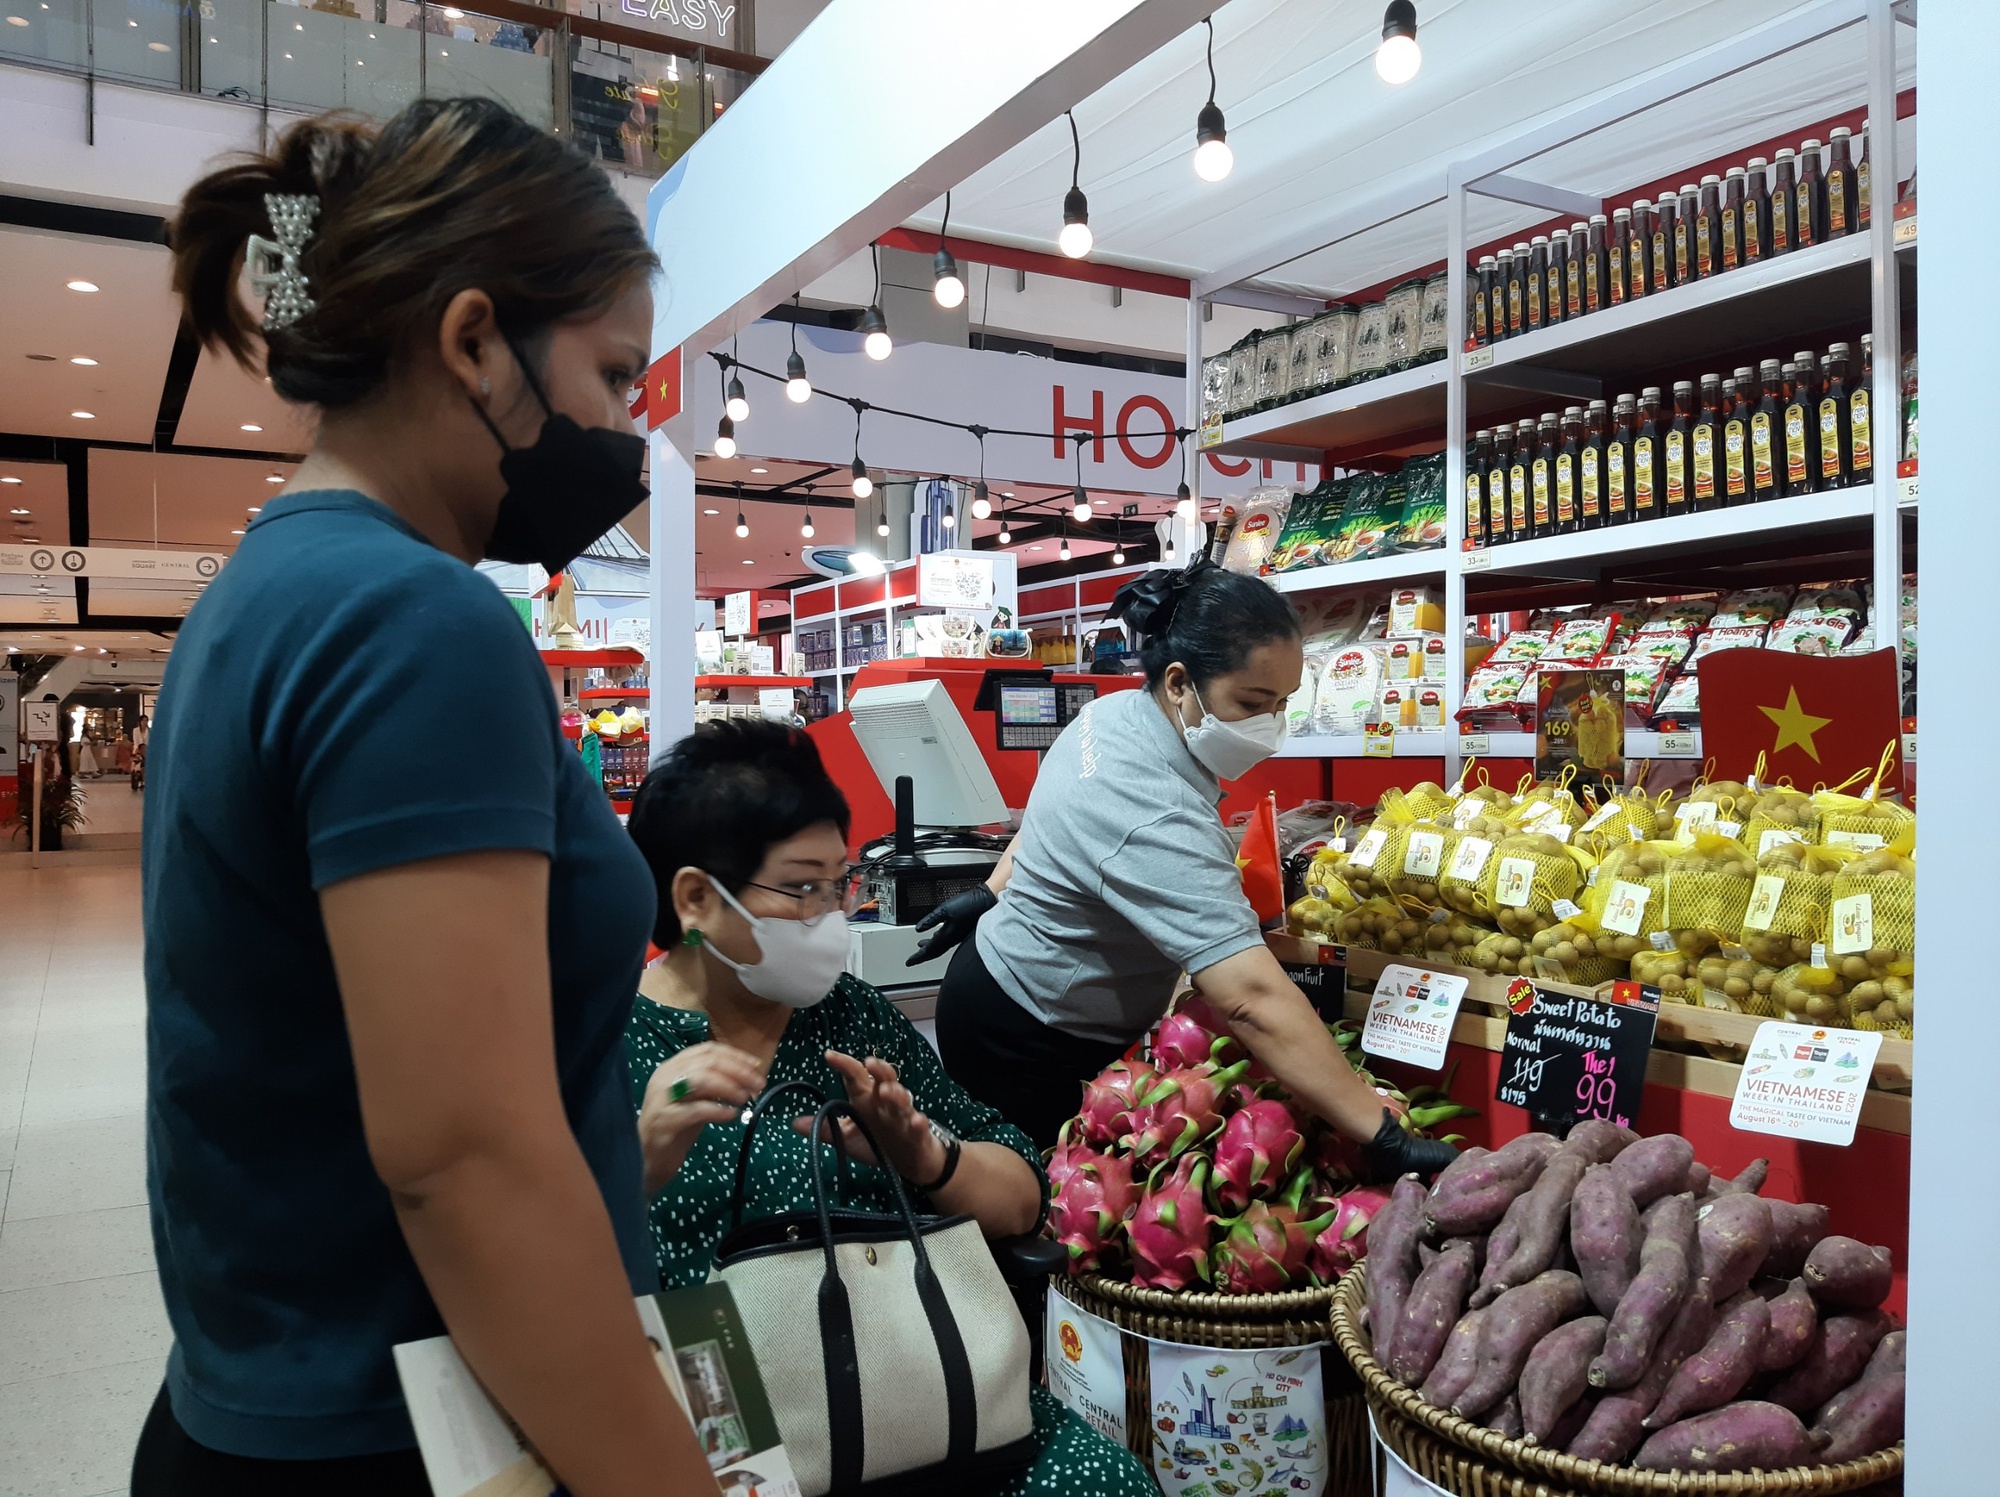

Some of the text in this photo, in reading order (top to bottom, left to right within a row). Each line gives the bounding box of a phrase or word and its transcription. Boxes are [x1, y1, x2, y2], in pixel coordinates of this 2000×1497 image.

[1053, 385, 1176, 469] HO
[1467, 557, 1476, 565] 33
[1380, 724, 1392, 734] Sale
[1465, 741, 1474, 749] 55
[1665, 740, 1676, 748] 55
[1509, 984, 1532, 1005] Sale
[1532, 994, 1622, 1028] Sweet Potato
[1369, 1022, 1387, 1032] WEEK
[1400, 1029, 1436, 1042] THAILAND
[1372, 1011, 1438, 1036] VIETNAMESE
[1366, 1038, 1385, 1049] August
[1376, 1034, 1397, 1044] MAGICAL
[1419, 1045, 1441, 1054] VIETNAM
[1438, 1026, 1447, 1044] 2023
[1507, 1031, 1541, 1053] Normal
[1581, 1049, 1607, 1074] The
[1576, 1074, 1616, 1121] 99
[1742, 1091, 1842, 1112] WEEK IN THAILAND
[1746, 1078, 1846, 1104] VIETNAMESE
[1845, 1091, 1858, 1114] 2023
[1737, 1112, 1765, 1123] August
[1739, 1104, 1751, 1112] THE
[1752, 1106, 1785, 1117] MAGICAL
[1786, 1111, 1806, 1120] TASTE
[1818, 1116, 1850, 1126] VIETNAM
[1266, 1372, 1303, 1387] HO CHI MINH
[1275, 1383, 1292, 1393] CITY
[1079, 1394, 1122, 1429] CENTRAL
[1085, 1411, 1117, 1439] RETAIL
